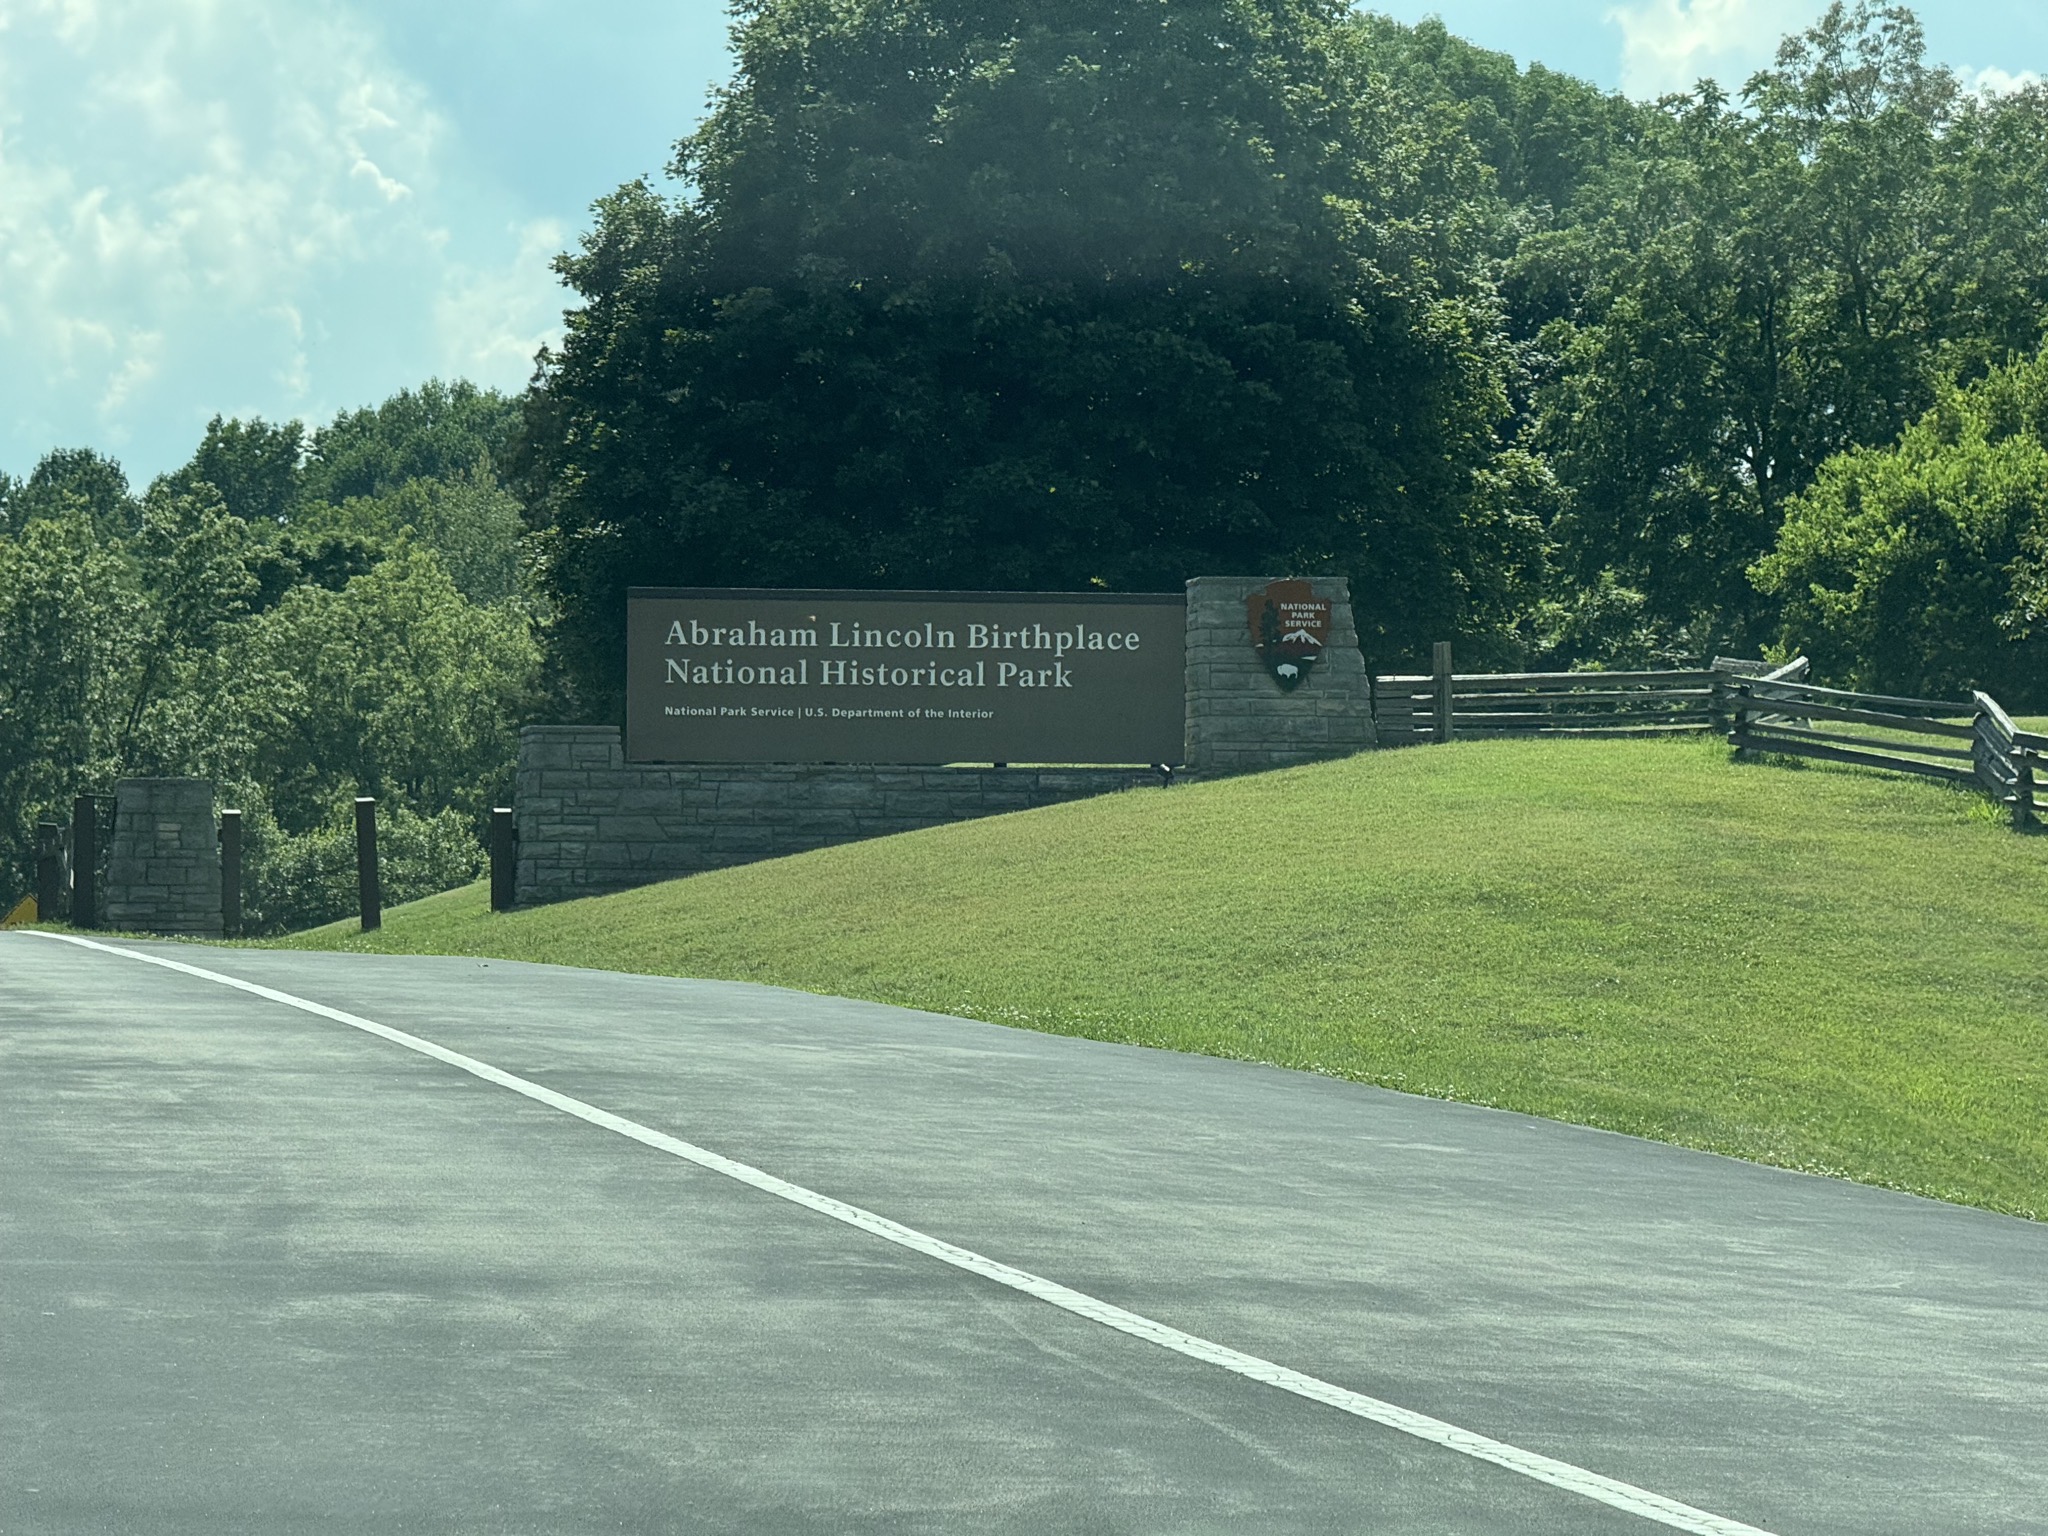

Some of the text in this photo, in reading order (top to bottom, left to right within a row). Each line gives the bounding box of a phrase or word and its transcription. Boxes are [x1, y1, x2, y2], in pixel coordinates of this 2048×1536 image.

[1280, 603, 1327, 611] NATIONAL
[1284, 620, 1322, 628] SERVICE
[664, 620, 1140, 657] Abraham Lincoln Birthplace
[664, 658, 1073, 688] National Historical Park
[664, 706, 717, 716] National
[720, 706, 747, 716] Park
[750, 707, 794, 717] Service
[804, 707, 828, 717] U.S.
[831, 707, 904, 720] Department
[907, 708, 921, 718] of
[924, 708, 945, 718] the
[948, 708, 994, 719] Interior
